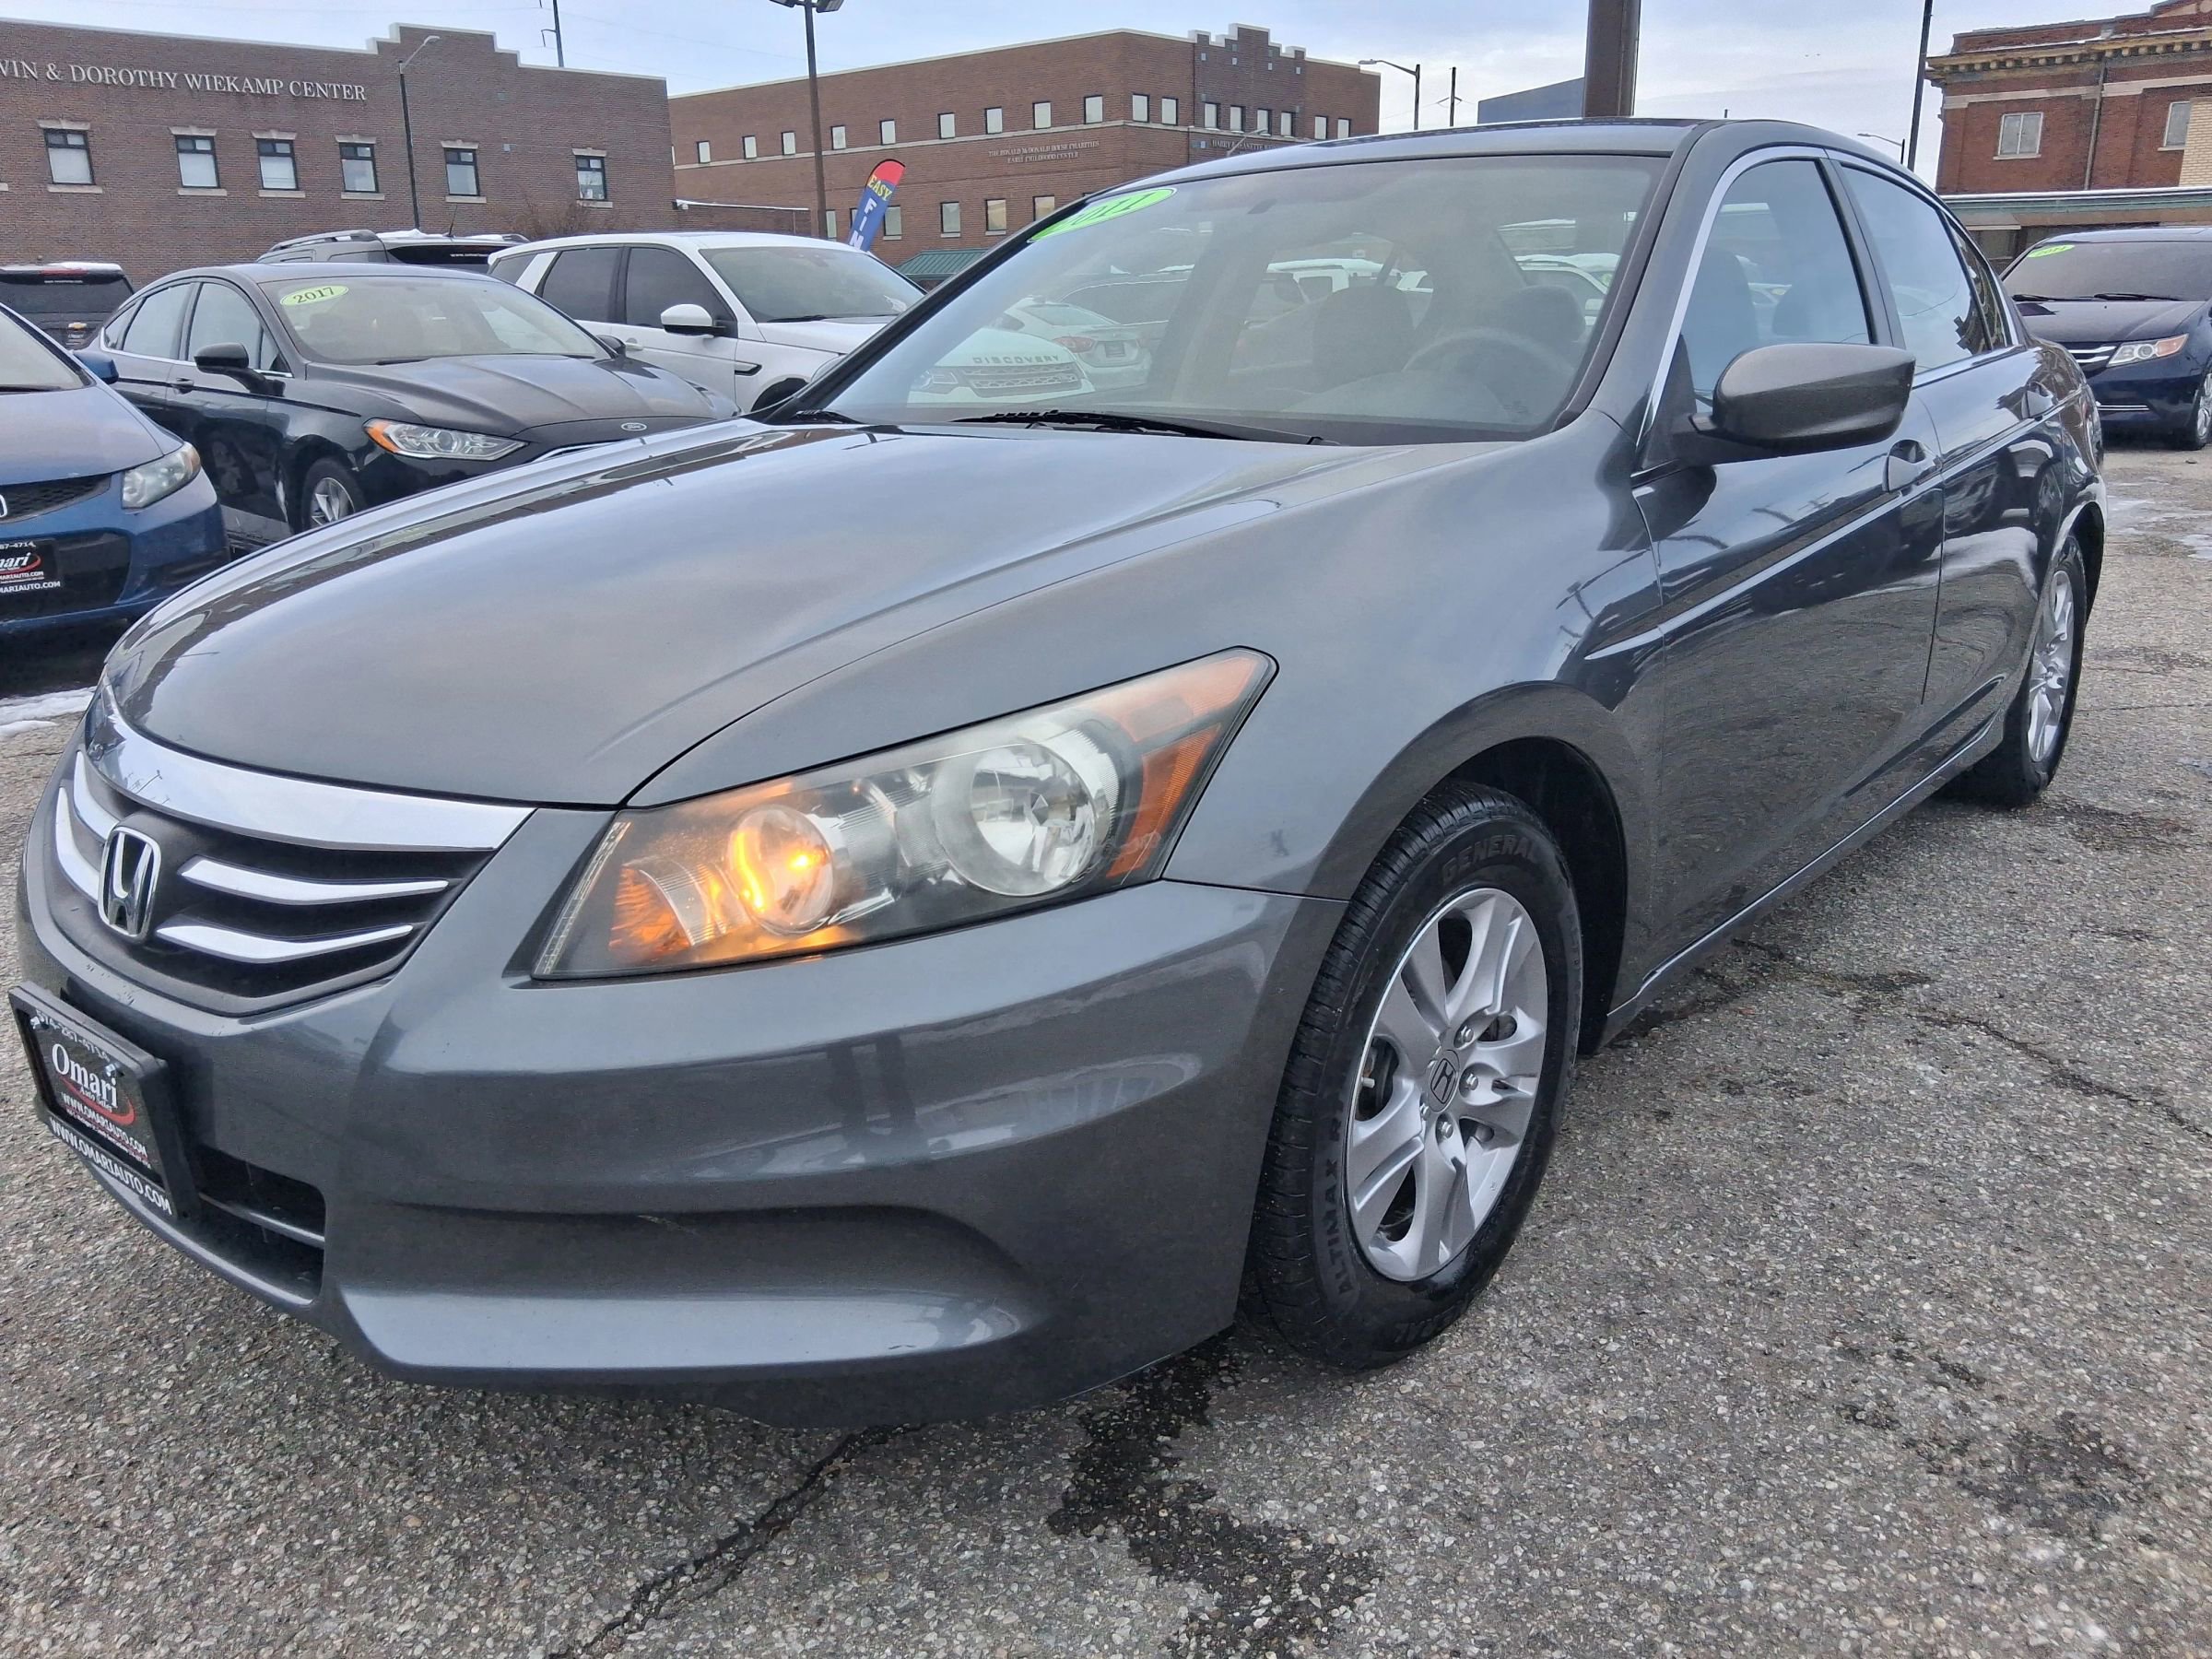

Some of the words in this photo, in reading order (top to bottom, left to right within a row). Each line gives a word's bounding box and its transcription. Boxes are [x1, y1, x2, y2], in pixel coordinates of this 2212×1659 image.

[46, 63, 62, 81] &
[70, 65, 177, 89] DOROTHY
[184, 73, 283, 95] WIEKAMP
[289, 80, 366, 100] CENTER
[867, 174, 892, 202] EASY
[293, 287, 335, 303] 2017
[973, 354, 1059, 364] DISCOVERY
[1441, 834, 1535, 886] GENERAL
[53, 1043, 118, 1108] Omari
[50, 1117, 172, 1215] WWW.OMARIAUTO.COM
[1324, 1159, 1353, 1293] ALTIMAX
